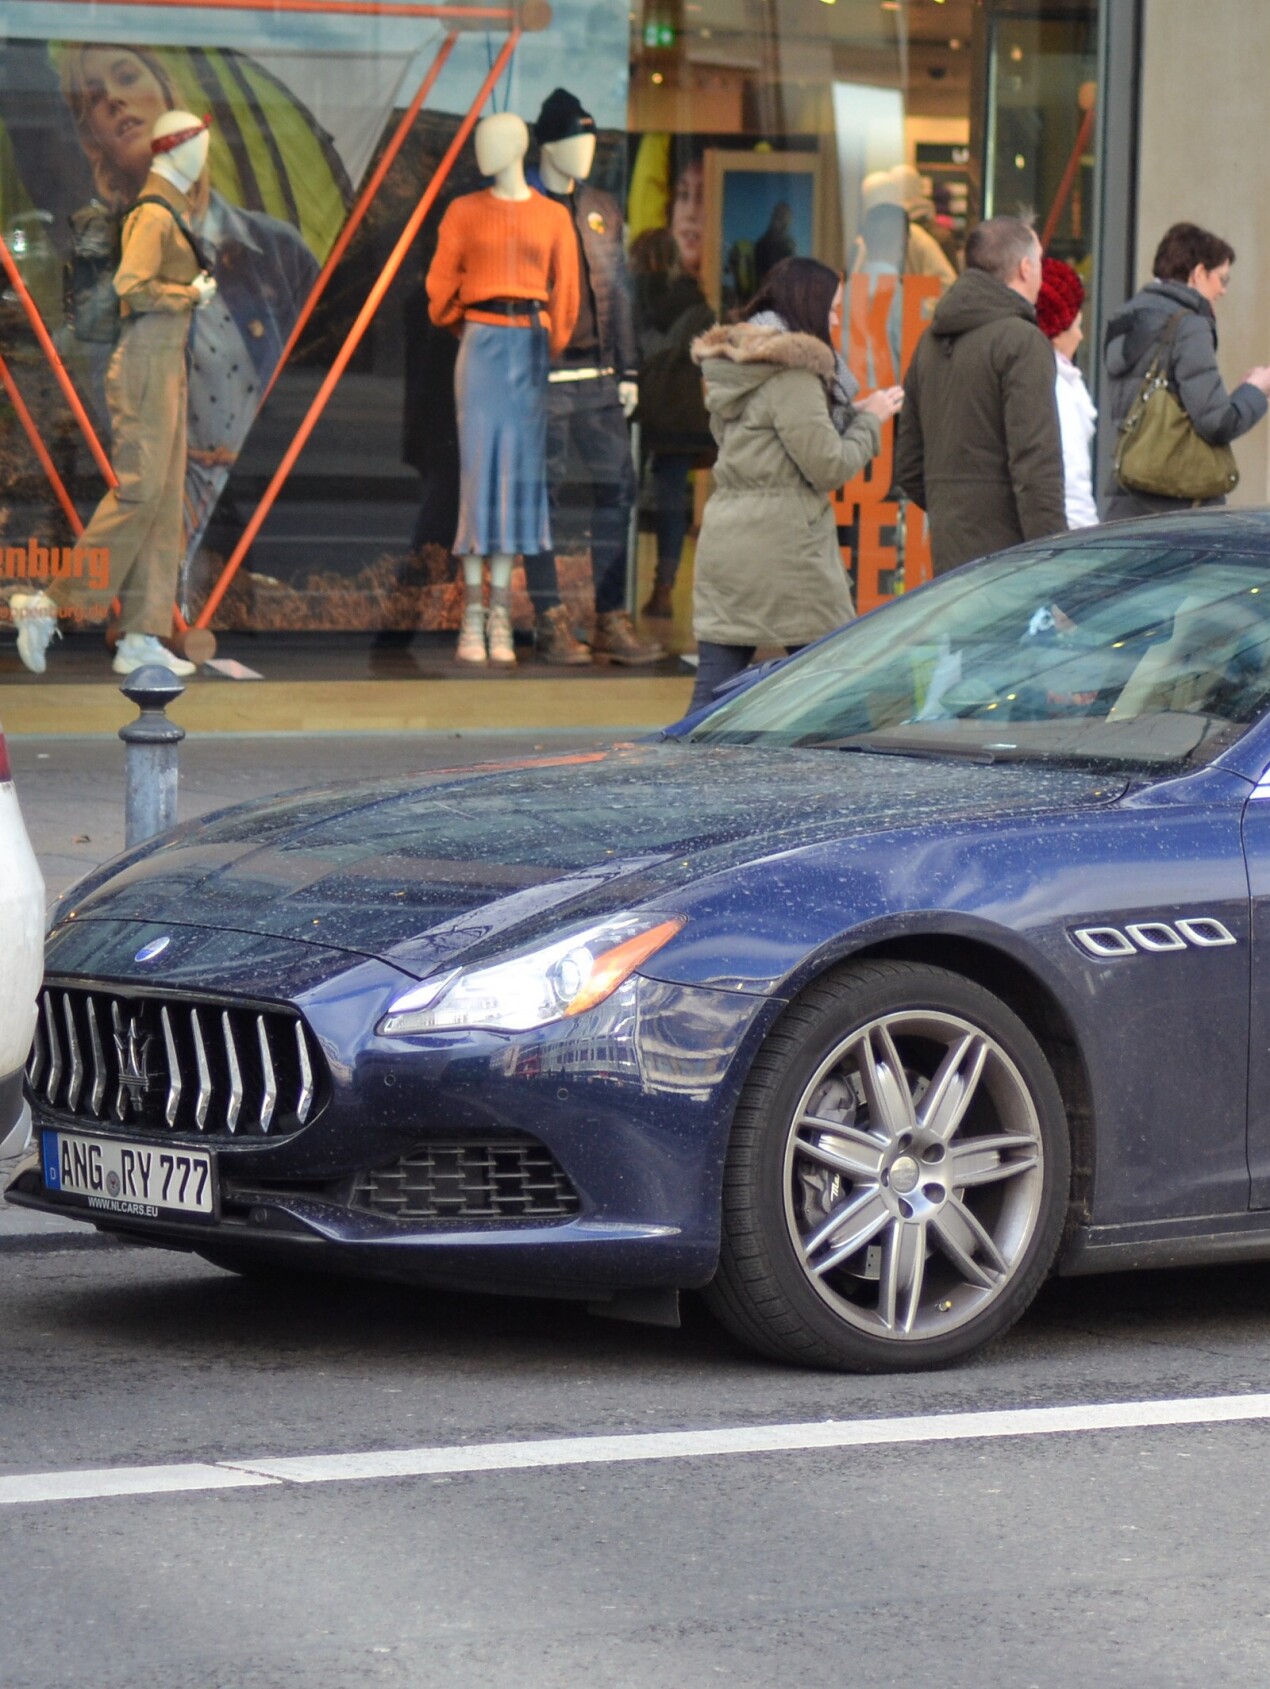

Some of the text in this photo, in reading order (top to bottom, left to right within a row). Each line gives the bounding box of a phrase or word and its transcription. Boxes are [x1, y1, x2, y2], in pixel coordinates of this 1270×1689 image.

[50, 1167, 56, 1180] D
[62, 1139, 209, 1206] ANG RY 777
[88, 1196, 159, 1218] WWW.NLCARS.EU
